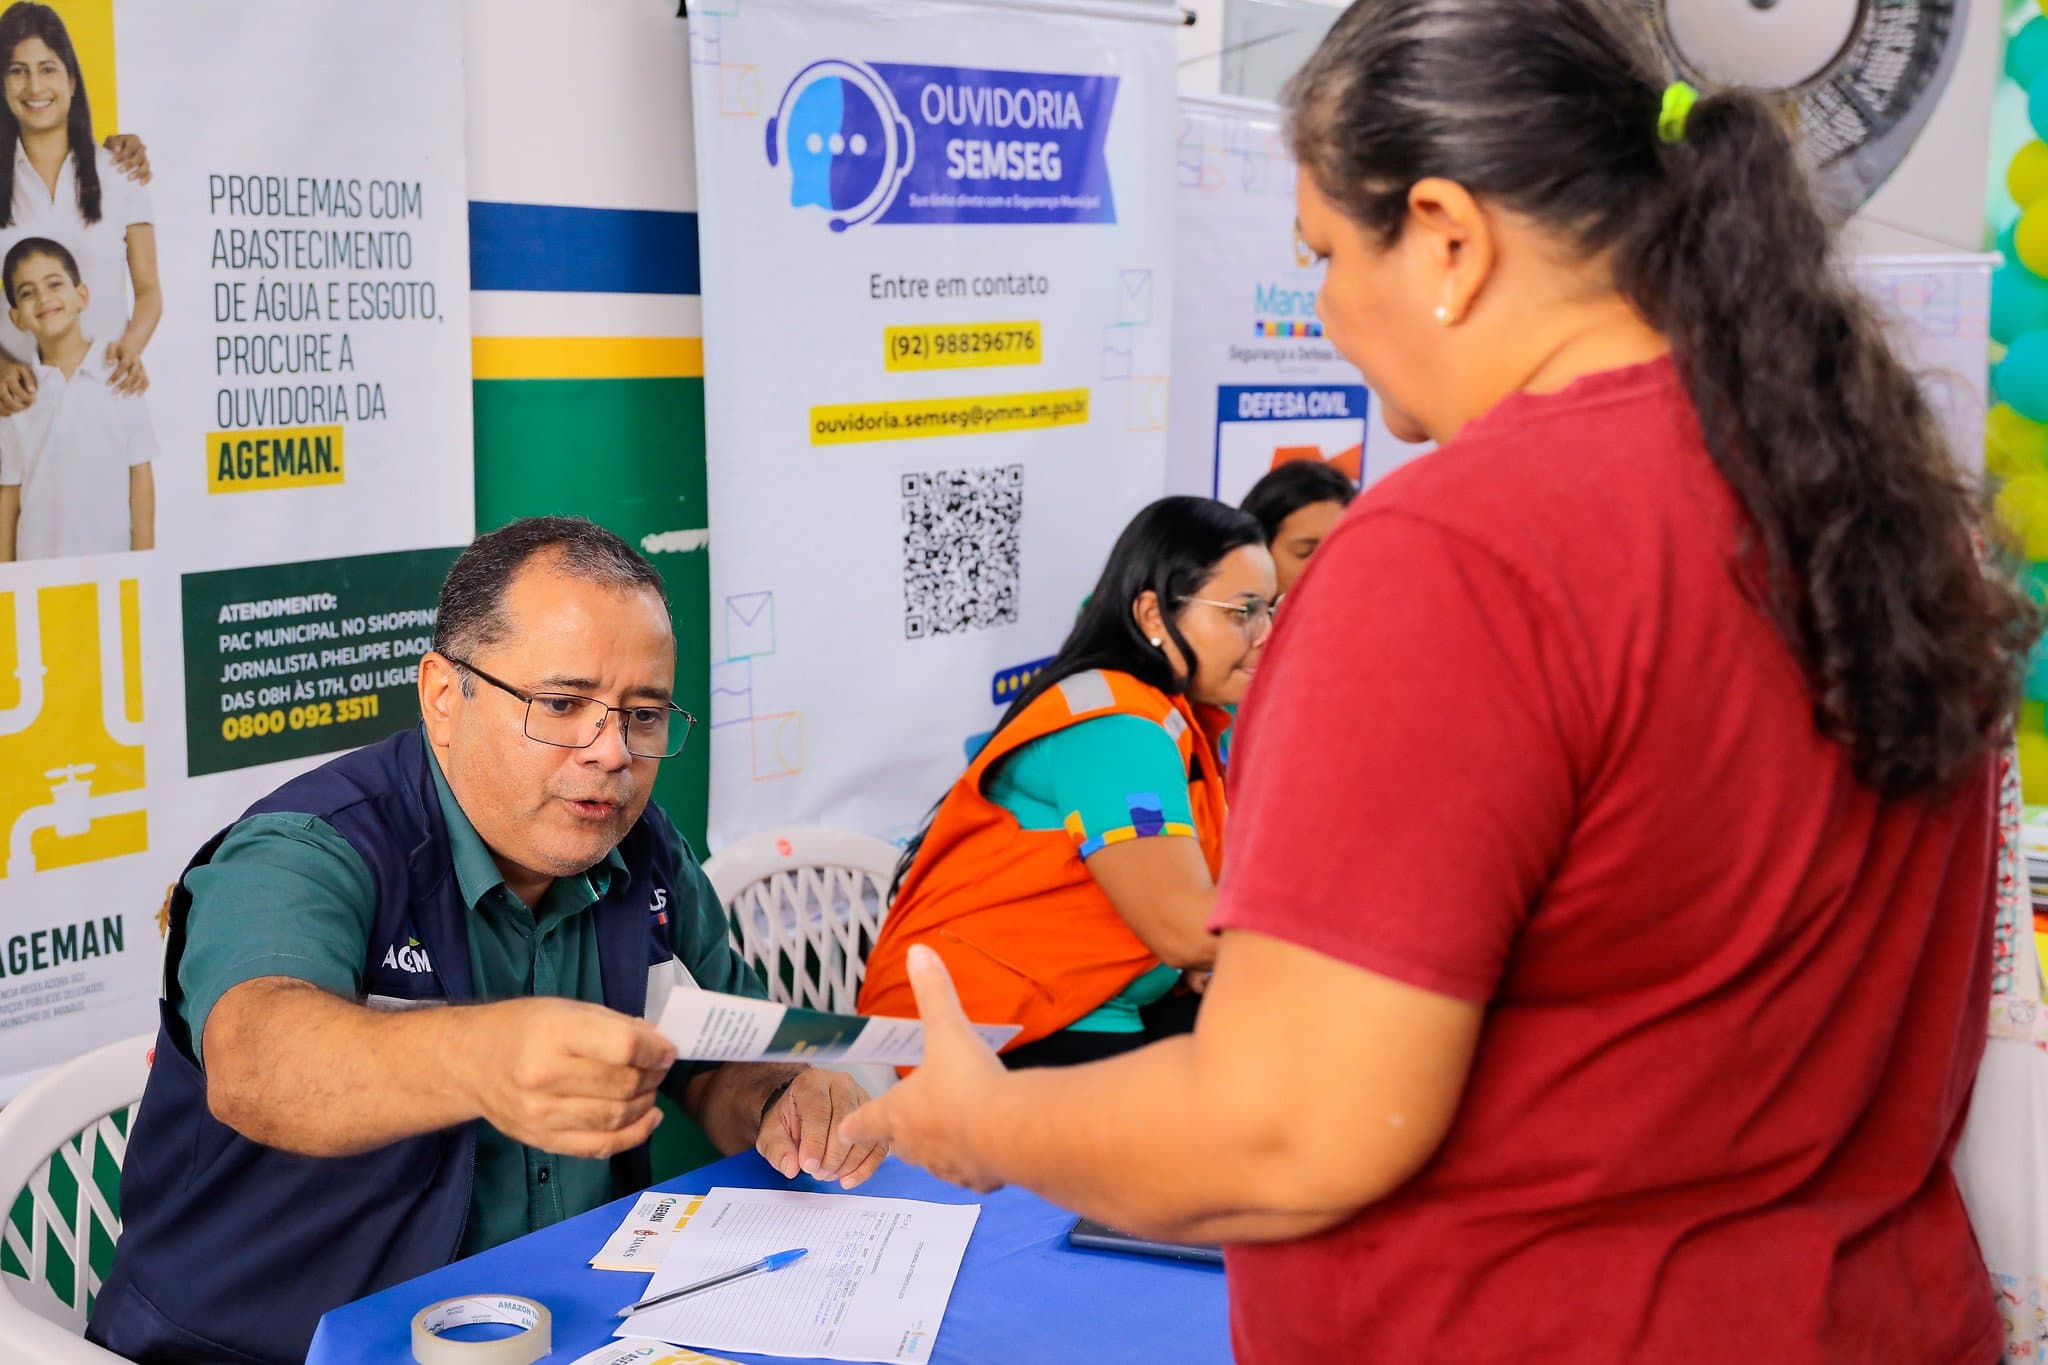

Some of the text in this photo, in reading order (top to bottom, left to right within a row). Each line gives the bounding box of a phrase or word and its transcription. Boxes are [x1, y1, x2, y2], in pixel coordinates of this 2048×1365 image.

[919, 83, 1084, 130] OUVIDORIA
[946, 138, 1063, 182] SEMSEG
[209, 174, 423, 220] PROBLEMAS COM
[211, 228, 413, 269] ABASTECIMENTO
[214, 276, 445, 324] DE ÁGUA E ESGOTO,
[870, 272, 1050, 300] Entre em contato
[1255, 281, 1317, 317] Mana
[216, 333, 354, 376] PROCURE A
[891, 330, 1036, 361] (92) 988296776
[217, 383, 387, 428] OUVIDORIA DA
[1238, 391, 1350, 419] DEFESA CIVIL
[217, 435, 340, 481] AGEMAN.
[218, 593, 337, 624] ATENDIMENTO:
[219, 632, 252, 653] PAC
[255, 622, 339, 649] MUNICIPAL
[342, 618, 365, 637] NO
[220, 653, 318, 683] JORNALISTA
[321, 641, 391, 668] PHELIPPE
[221, 693, 255, 713] DAS
[258, 687, 291, 707] 08H
[293, 680, 315, 701] ÀS
[318, 676, 348, 698] 17H,
[350, 672, 373, 692] OU
[222, 694, 379, 742] 0800 092 3511
